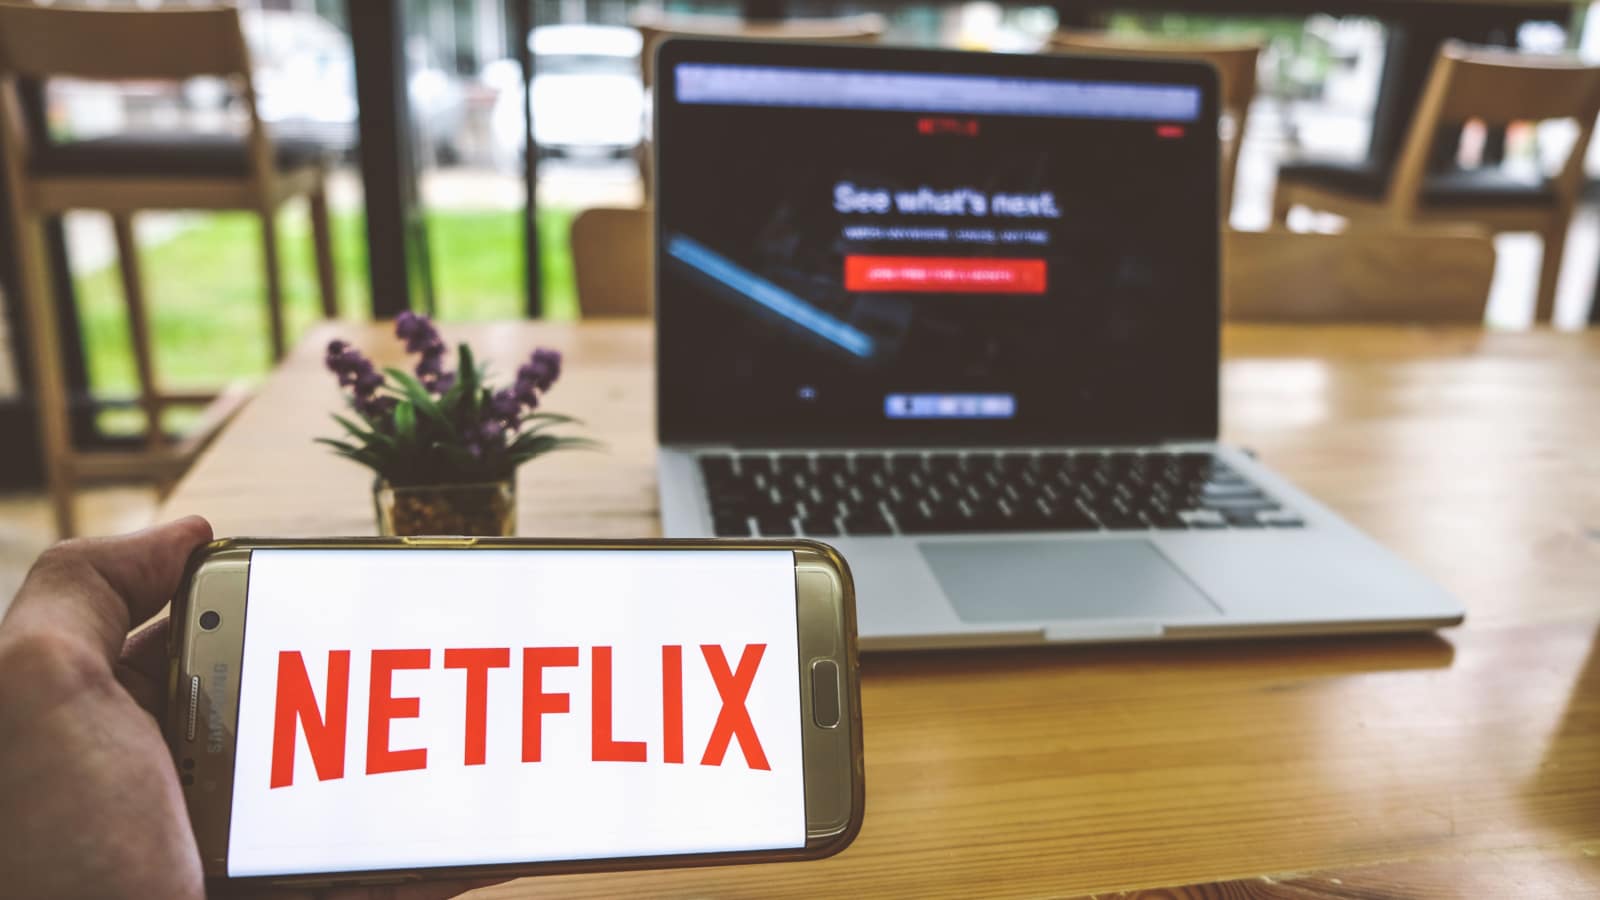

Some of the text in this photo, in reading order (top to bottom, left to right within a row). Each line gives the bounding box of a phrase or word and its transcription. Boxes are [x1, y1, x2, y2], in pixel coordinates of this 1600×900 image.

[834, 183, 1061, 218] See what's next.
[270, 643, 771, 788] NETFLIX
